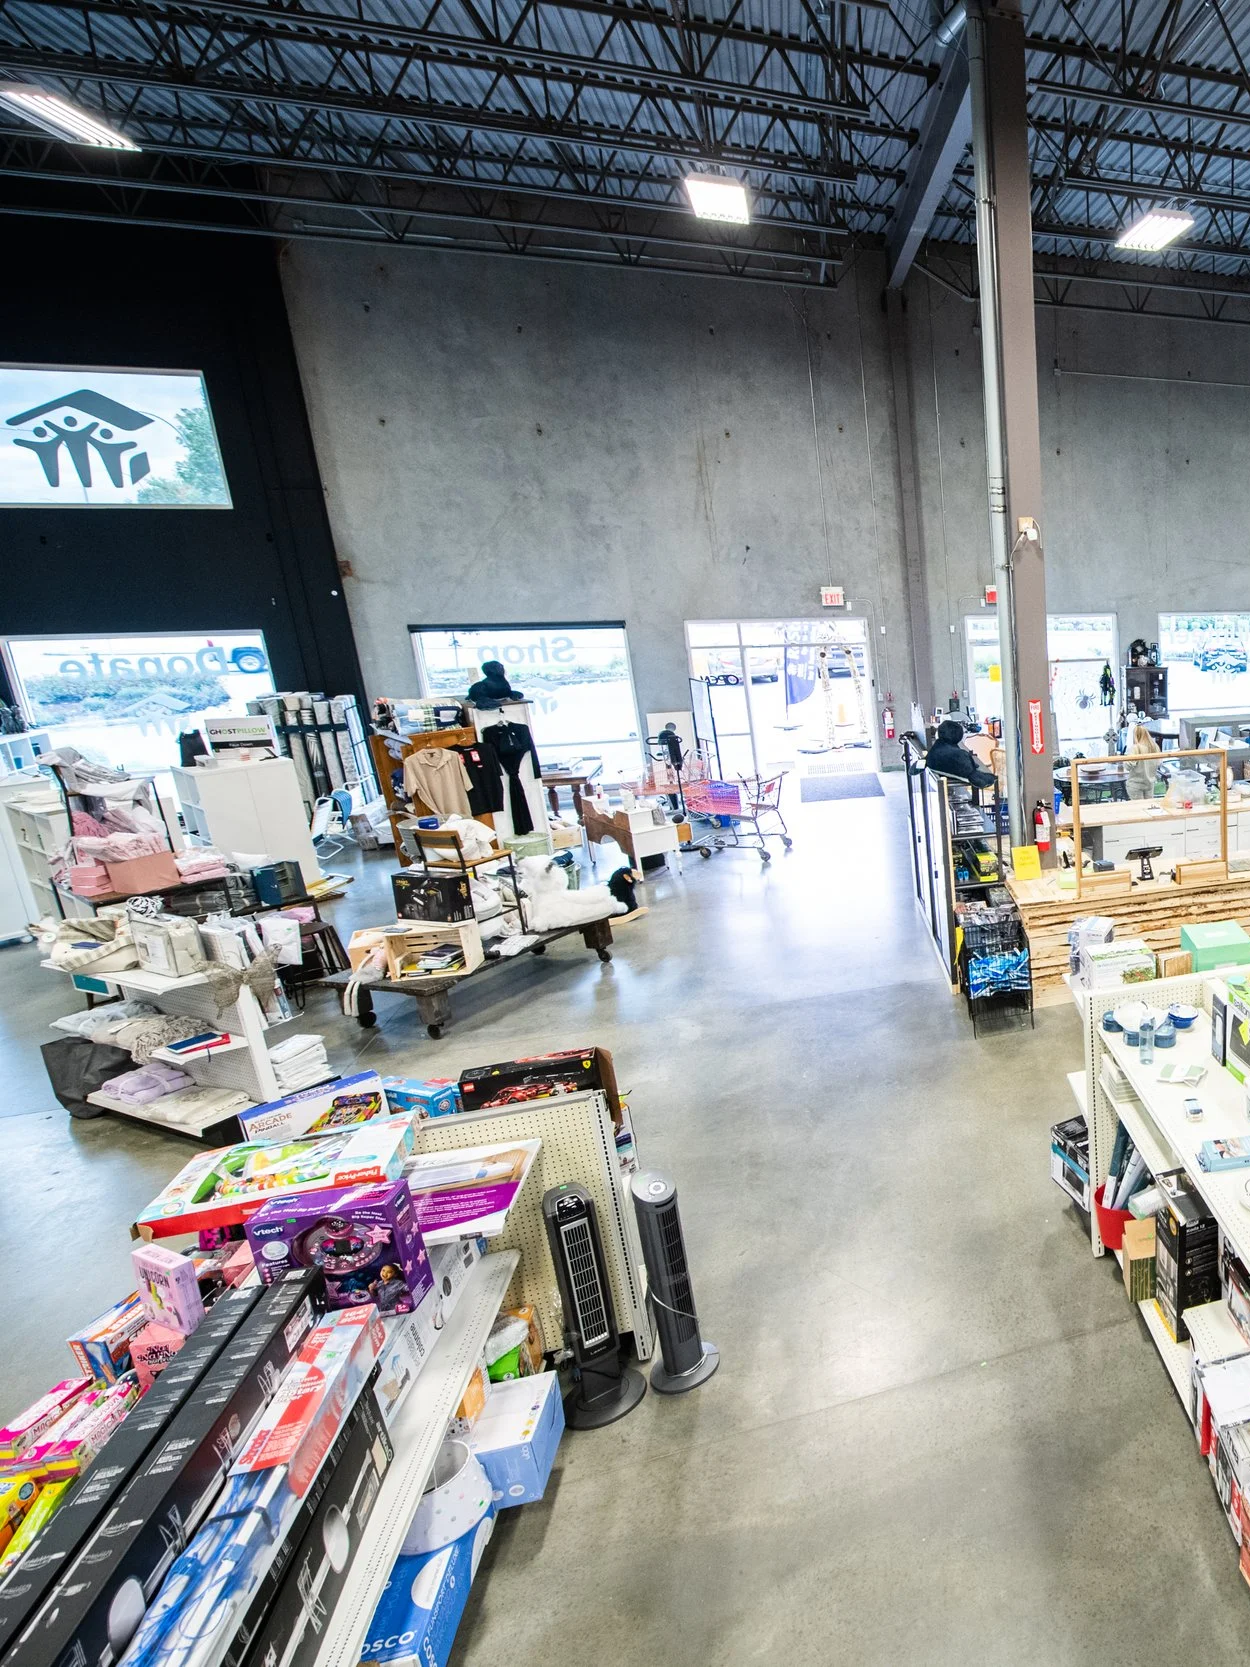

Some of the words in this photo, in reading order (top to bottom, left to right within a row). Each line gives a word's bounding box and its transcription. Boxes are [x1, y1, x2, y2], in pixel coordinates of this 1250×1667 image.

[824, 593, 841, 605] EXIT
[249, 1113, 293, 1132] ARCADE
[253, 1226, 284, 1238] vtech
[261, 1258, 288, 1269] Features
[138, 1266, 171, 1289] UNICORN
[375, 1422, 391, 1452] artika
